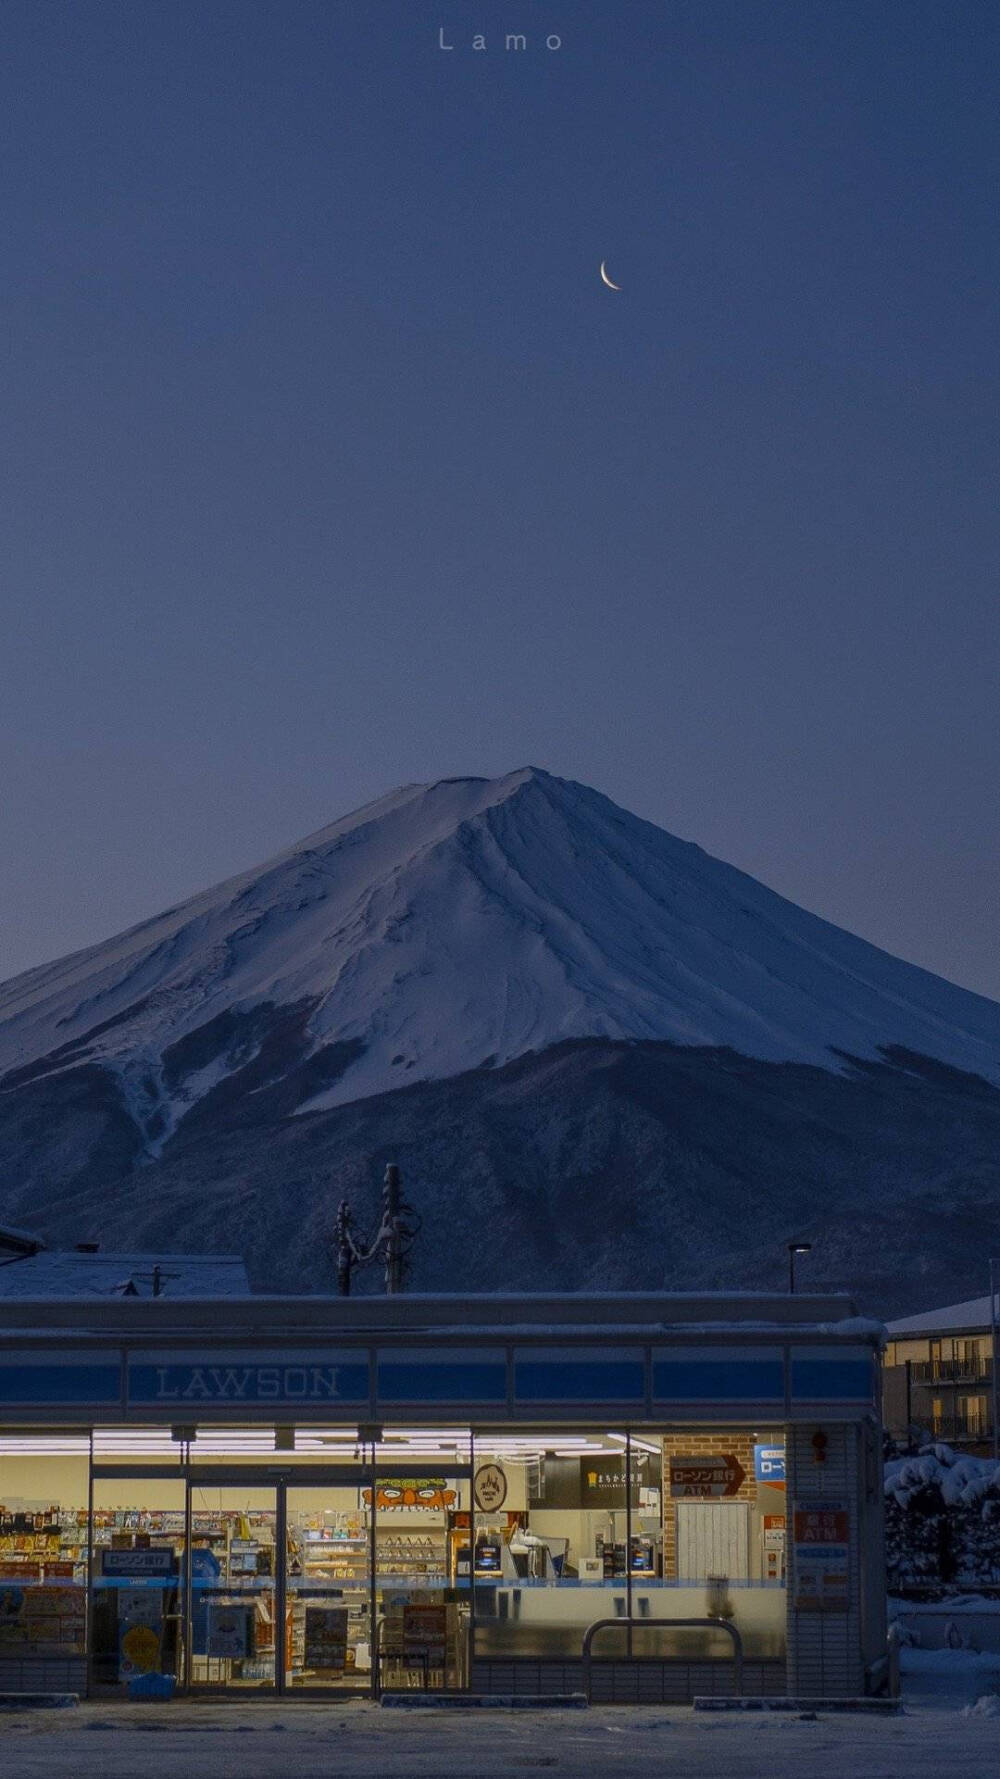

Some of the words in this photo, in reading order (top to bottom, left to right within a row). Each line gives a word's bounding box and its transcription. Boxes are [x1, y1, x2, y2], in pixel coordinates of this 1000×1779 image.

[156, 1367, 341, 1397] LAWSON
[673, 1469, 736, 1482] ローソン銀行
[683, 1485, 712, 1496] ATM
[804, 1527, 837, 1540] ATM
